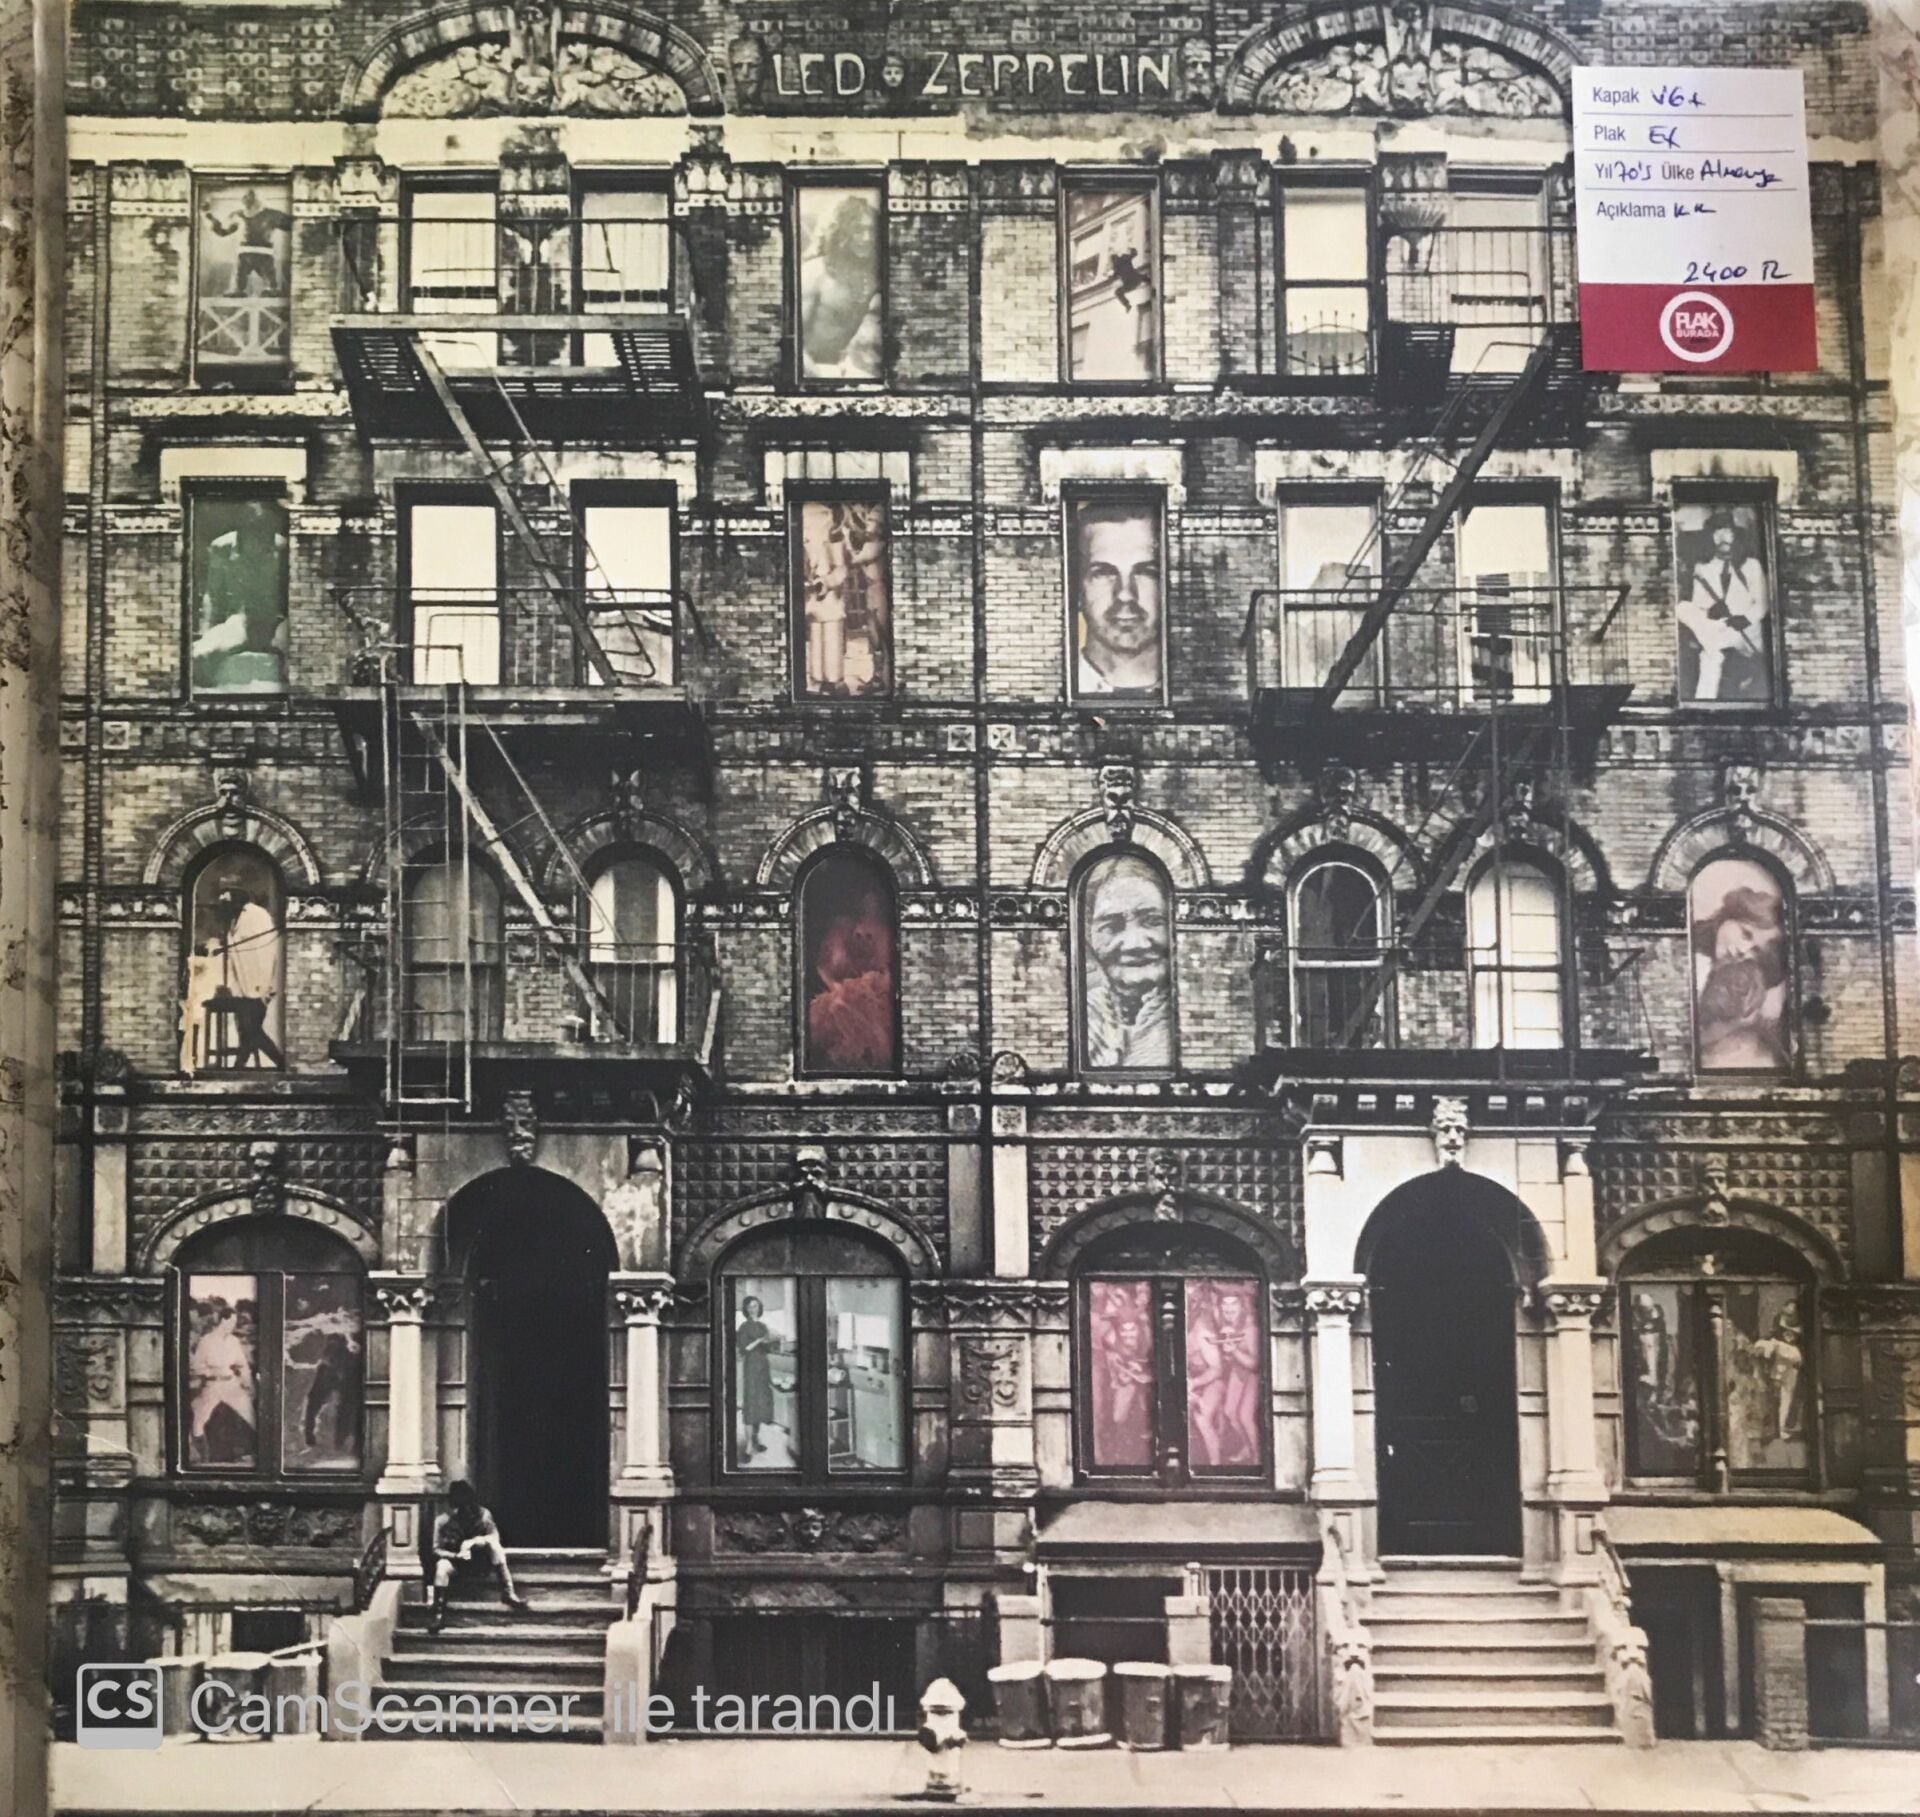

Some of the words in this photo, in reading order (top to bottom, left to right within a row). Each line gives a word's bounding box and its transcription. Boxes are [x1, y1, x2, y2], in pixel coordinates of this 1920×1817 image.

[772, 53, 865, 96] LED
[921, 51, 1172, 96] ZEPPELIN
[1593, 87, 1640, 106] Kapak
[1594, 125, 1626, 141] Plak
[1595, 163, 1613, 180] Yıl
[1661, 160, 1695, 181] Ülke
[1596, 201, 1667, 220] Açıklama
[1683, 261, 1748, 284] 2400
[1675, 312, 1719, 330] PLAK
[1676, 329, 1720, 338] BURADA
